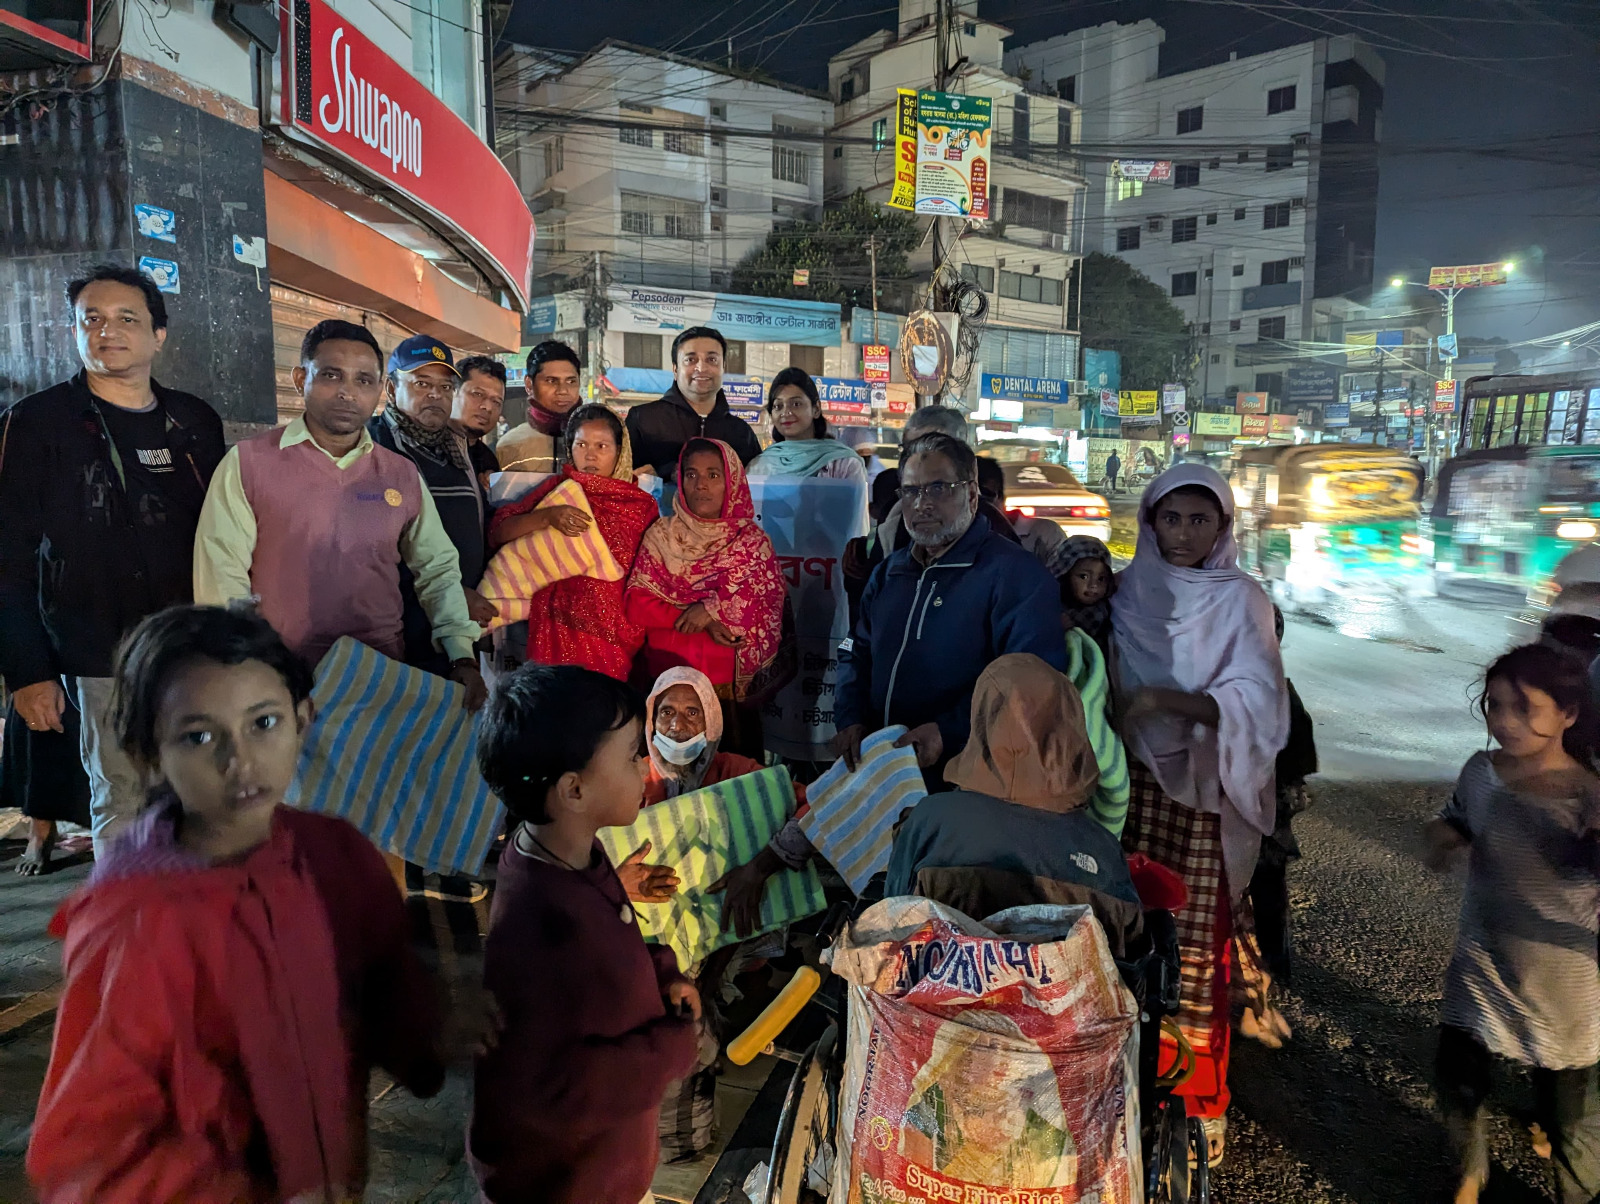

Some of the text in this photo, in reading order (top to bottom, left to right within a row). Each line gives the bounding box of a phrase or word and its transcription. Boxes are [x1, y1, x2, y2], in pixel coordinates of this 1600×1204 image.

[319, 27, 422, 178] Shwapno
[631, 289, 686, 304] Pepsodent
[661, 305, 685, 313] expert
[717, 311, 732, 322] ডাঃ
[735, 311, 772, 326] জাহাঙ্গীর
[866, 346, 886, 356] SSC
[1004, 377, 1061, 394] DENTAL ARENA
[1438, 381, 1453, 390] SSC
[906, 1164, 1063, 1204] Super Fine Rice
